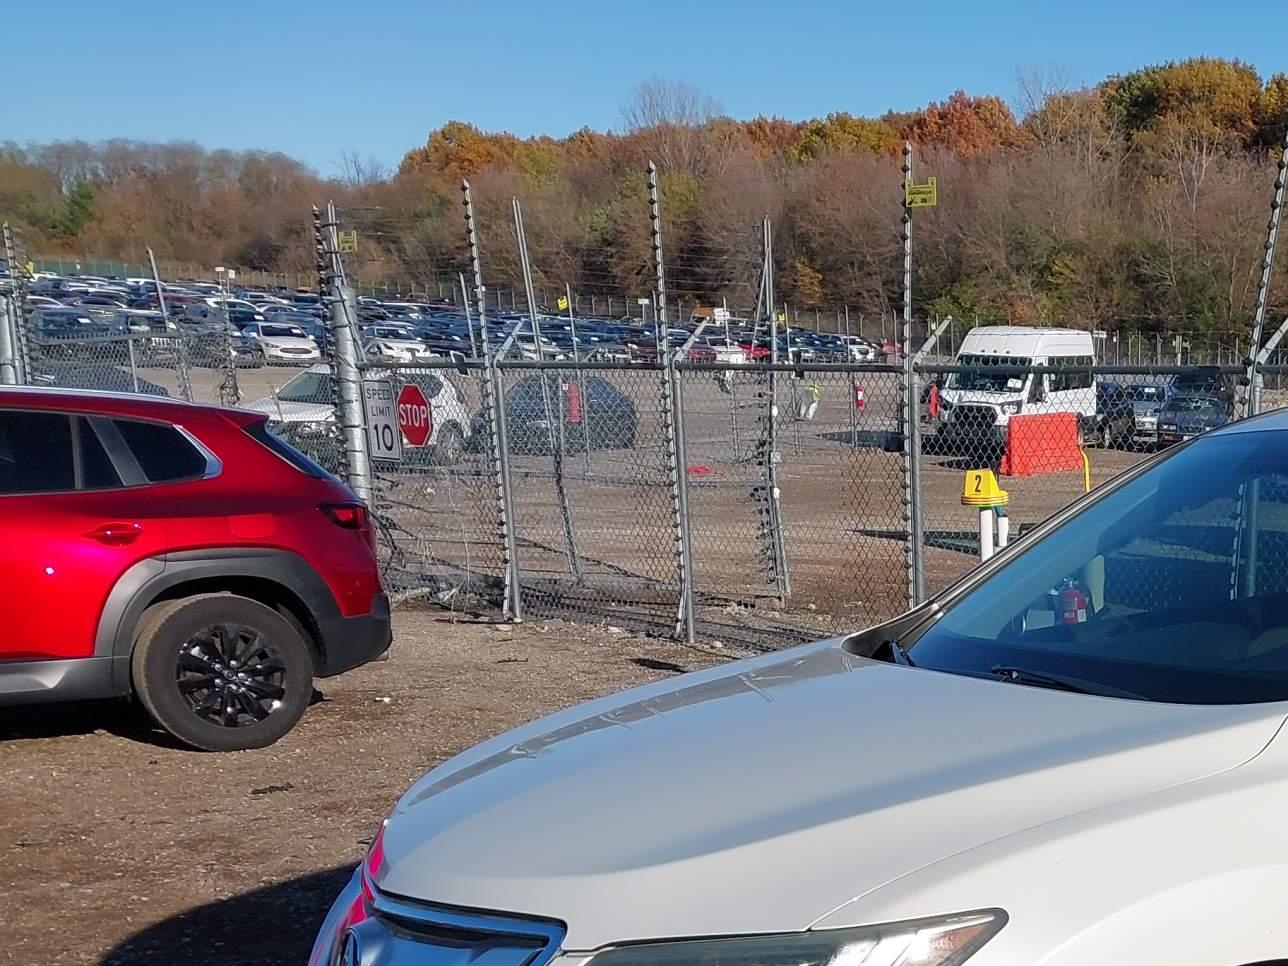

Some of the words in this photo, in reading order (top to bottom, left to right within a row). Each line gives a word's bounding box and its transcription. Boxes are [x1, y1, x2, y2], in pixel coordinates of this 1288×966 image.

[370, 406, 391, 417] LIMIT
[399, 403, 427, 428] STOP
[373, 423, 394, 452] 10
[974, 474, 982, 493] 2
